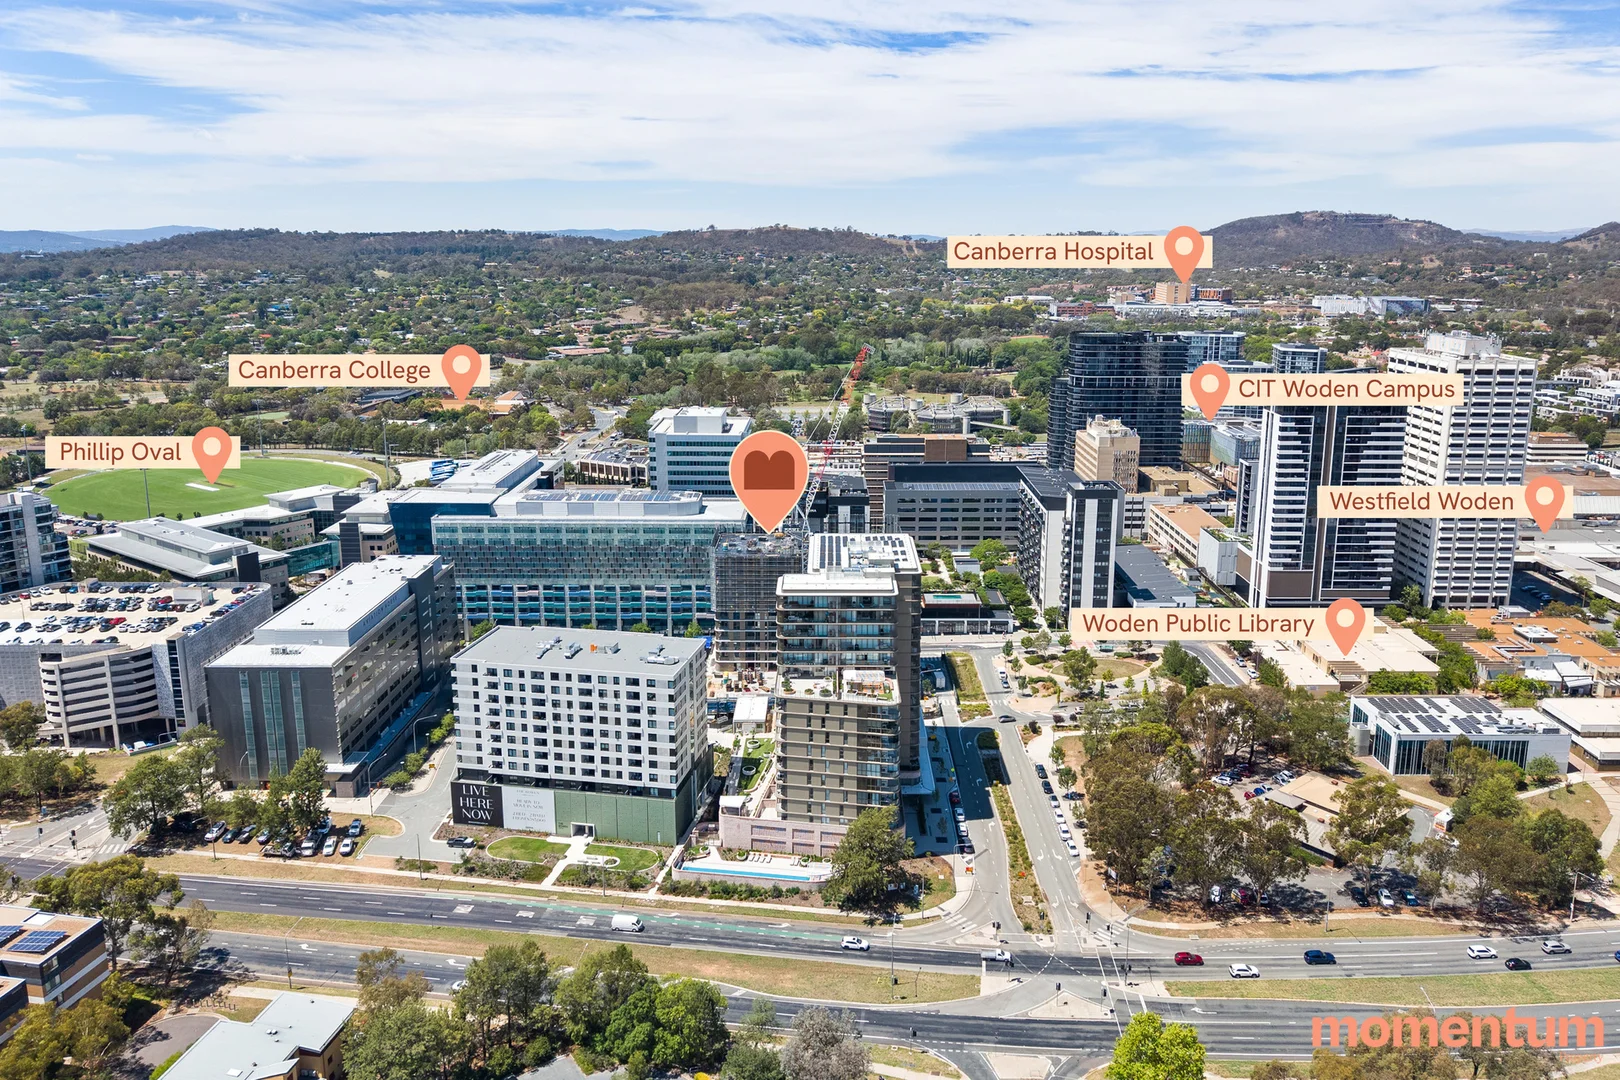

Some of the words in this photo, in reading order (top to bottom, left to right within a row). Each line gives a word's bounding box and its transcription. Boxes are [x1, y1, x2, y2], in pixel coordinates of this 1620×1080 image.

[462, 784, 490, 797] LIVE
[460, 796, 494, 810] HERE
[462, 808, 493, 820] NOW
